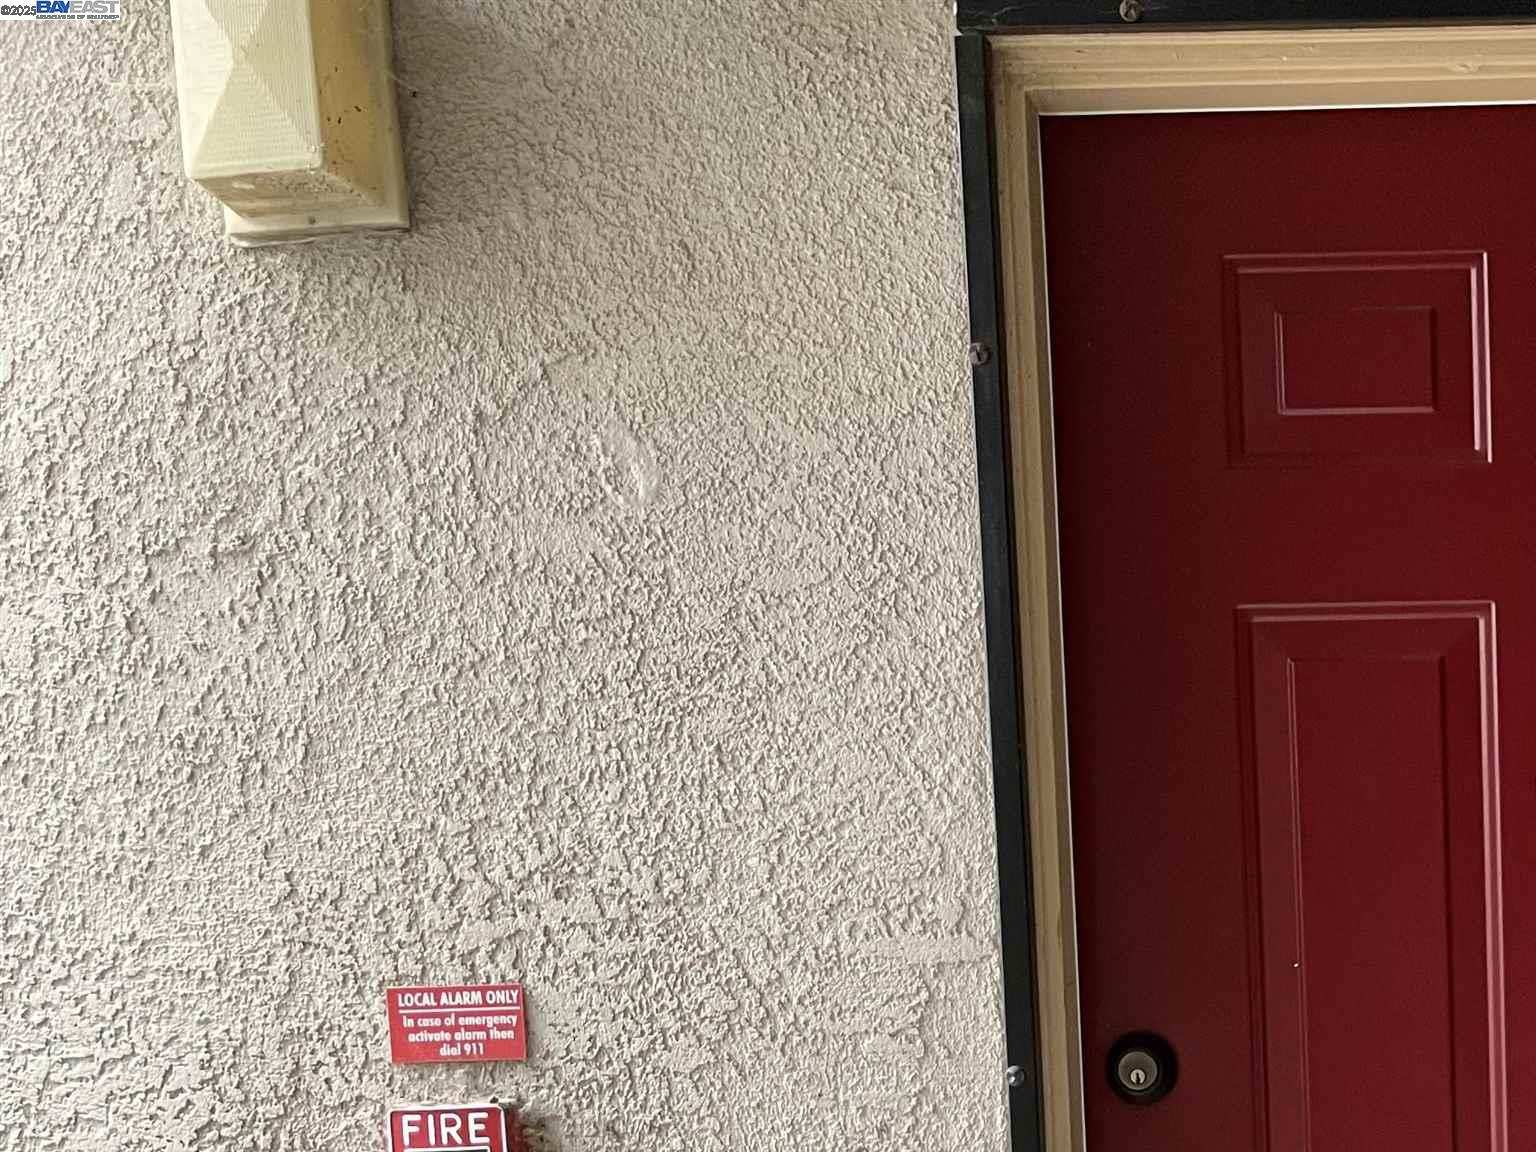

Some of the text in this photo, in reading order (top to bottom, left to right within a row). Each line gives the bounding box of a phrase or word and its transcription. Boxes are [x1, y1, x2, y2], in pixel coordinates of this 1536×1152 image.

[397, 989, 519, 1007] LOCAL ALARM ONLY
[402, 1013, 518, 1028] In case of emergency
[408, 1027, 515, 1042] activate alarm then
[440, 1043, 484, 1056] dial 911
[401, 1112, 491, 1146] FIRE
